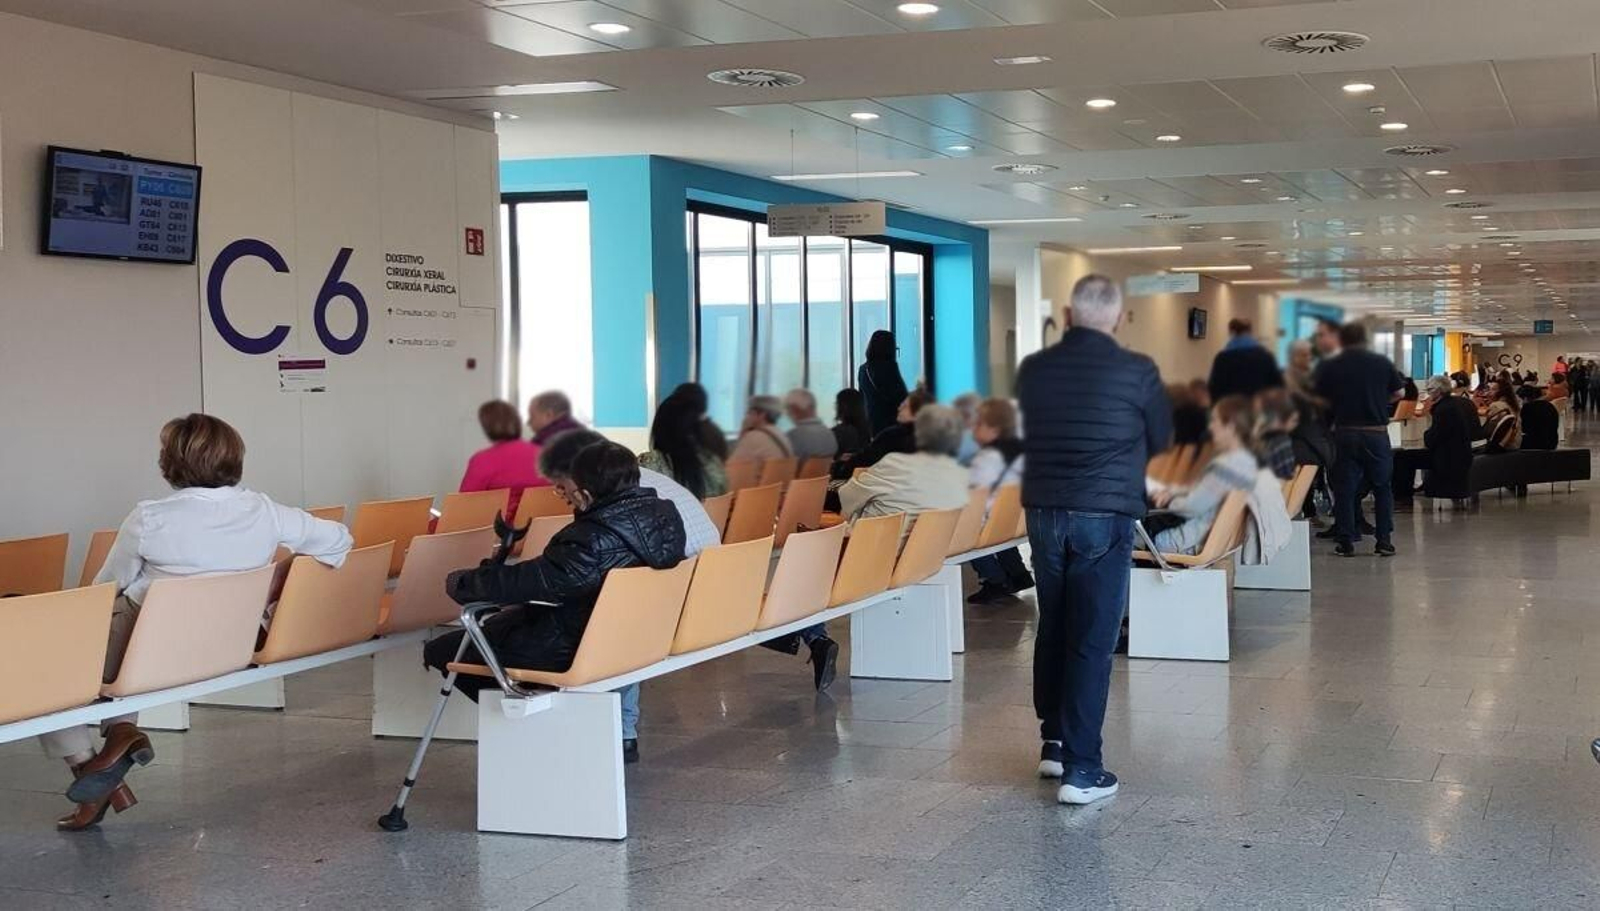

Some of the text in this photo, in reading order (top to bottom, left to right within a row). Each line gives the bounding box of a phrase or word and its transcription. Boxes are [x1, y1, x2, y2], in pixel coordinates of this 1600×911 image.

[385, 253, 424, 265] DIXESTIVO
[424, 269, 445, 280] XERAL
[424, 281, 456, 295] PLÁSTICA
